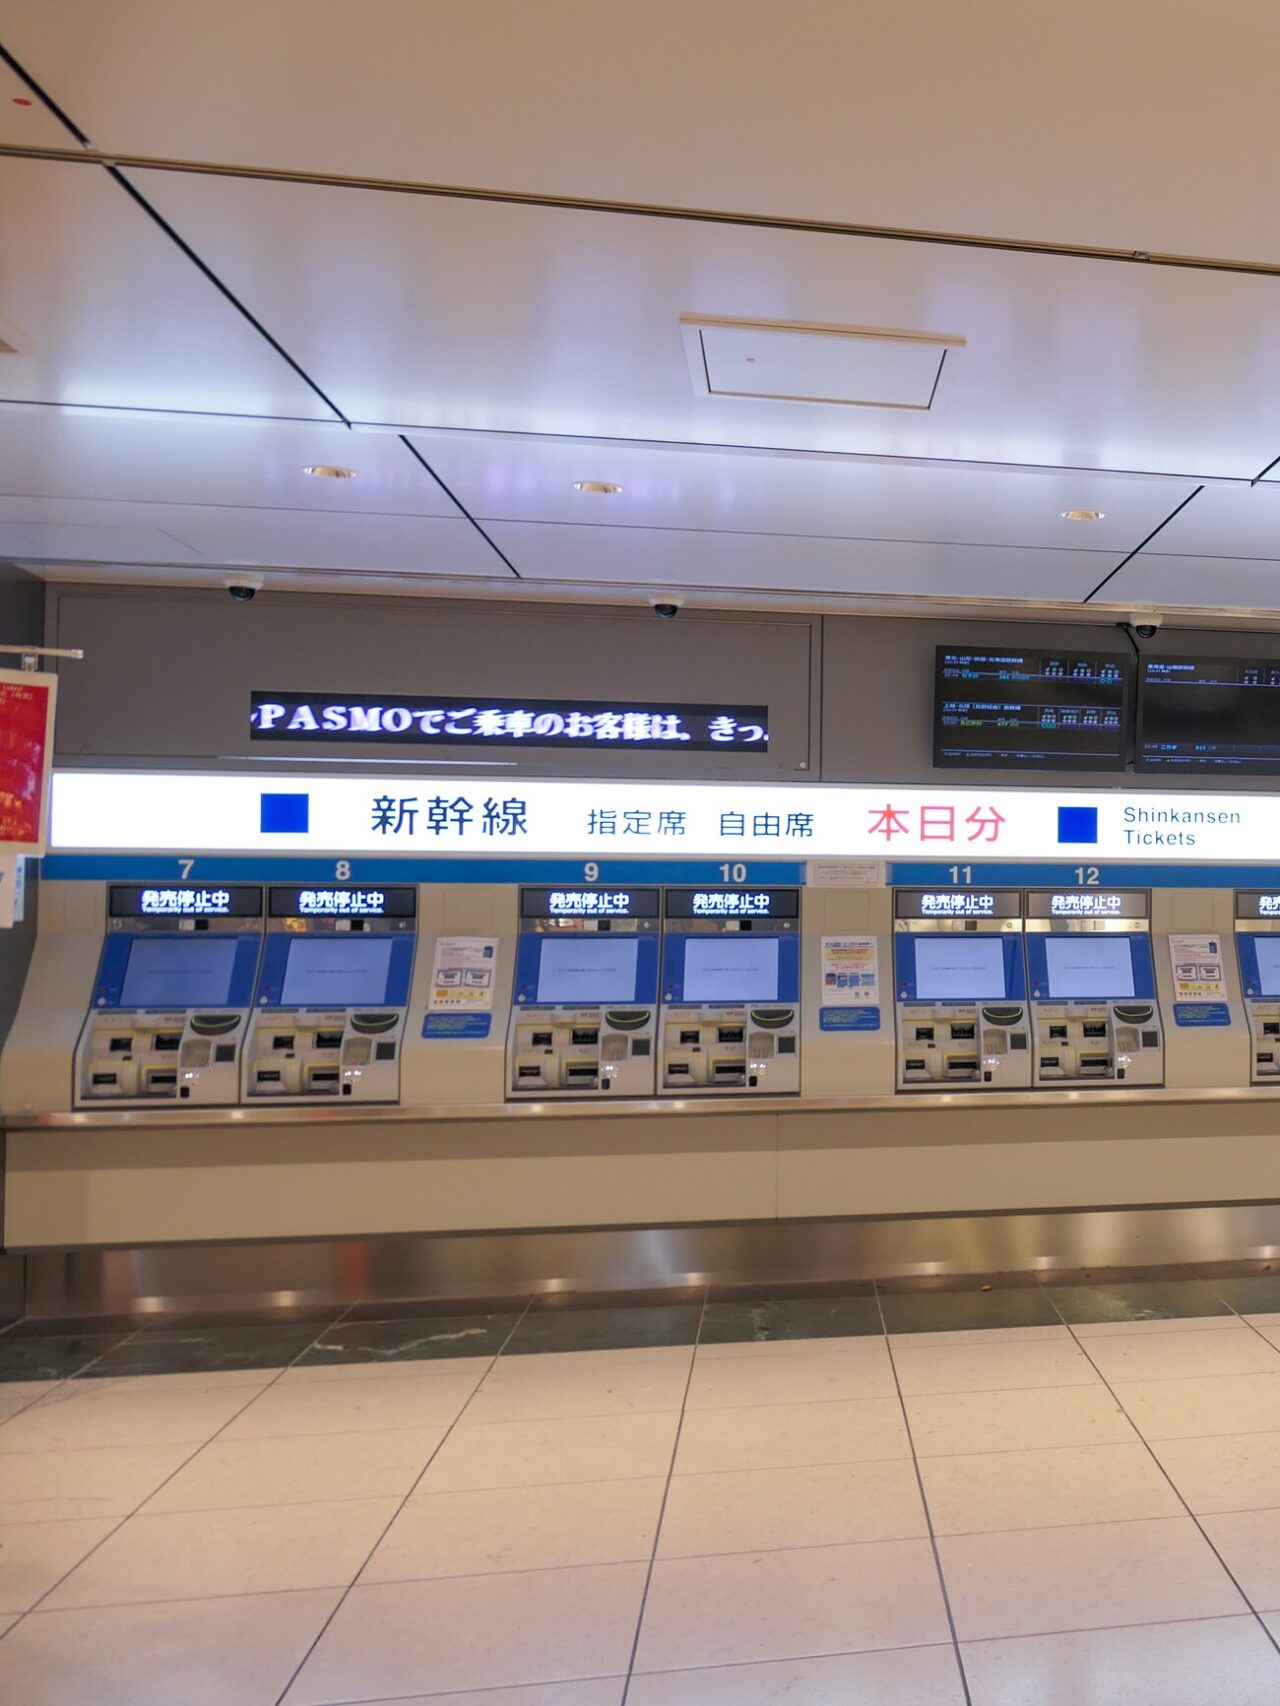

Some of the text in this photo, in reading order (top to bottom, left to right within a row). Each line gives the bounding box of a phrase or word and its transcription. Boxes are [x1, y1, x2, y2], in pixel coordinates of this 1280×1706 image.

[371, 795, 1006, 843] 新幹線 指定席 自由席 本日分
[1123, 806, 1241, 825] Shinkansen
[1123, 829, 1196, 847] Tickets
[178, 859, 194, 880] 7
[335, 860, 351, 880] 8
[584, 862, 599, 881] 9
[719, 864, 747, 883] 10
[949, 865, 972, 884] 11
[1075, 867, 1100, 885] 12
[142, 890, 230, 907] 発売停止中
[299, 891, 384, 908] 発売停止中
[549, 892, 629, 908] 発売停止中
[693, 893, 770, 908] 発売停止中
[921, 895, 993, 909] 発売停止中
[1051, 895, 1121, 910] 発売停止中
